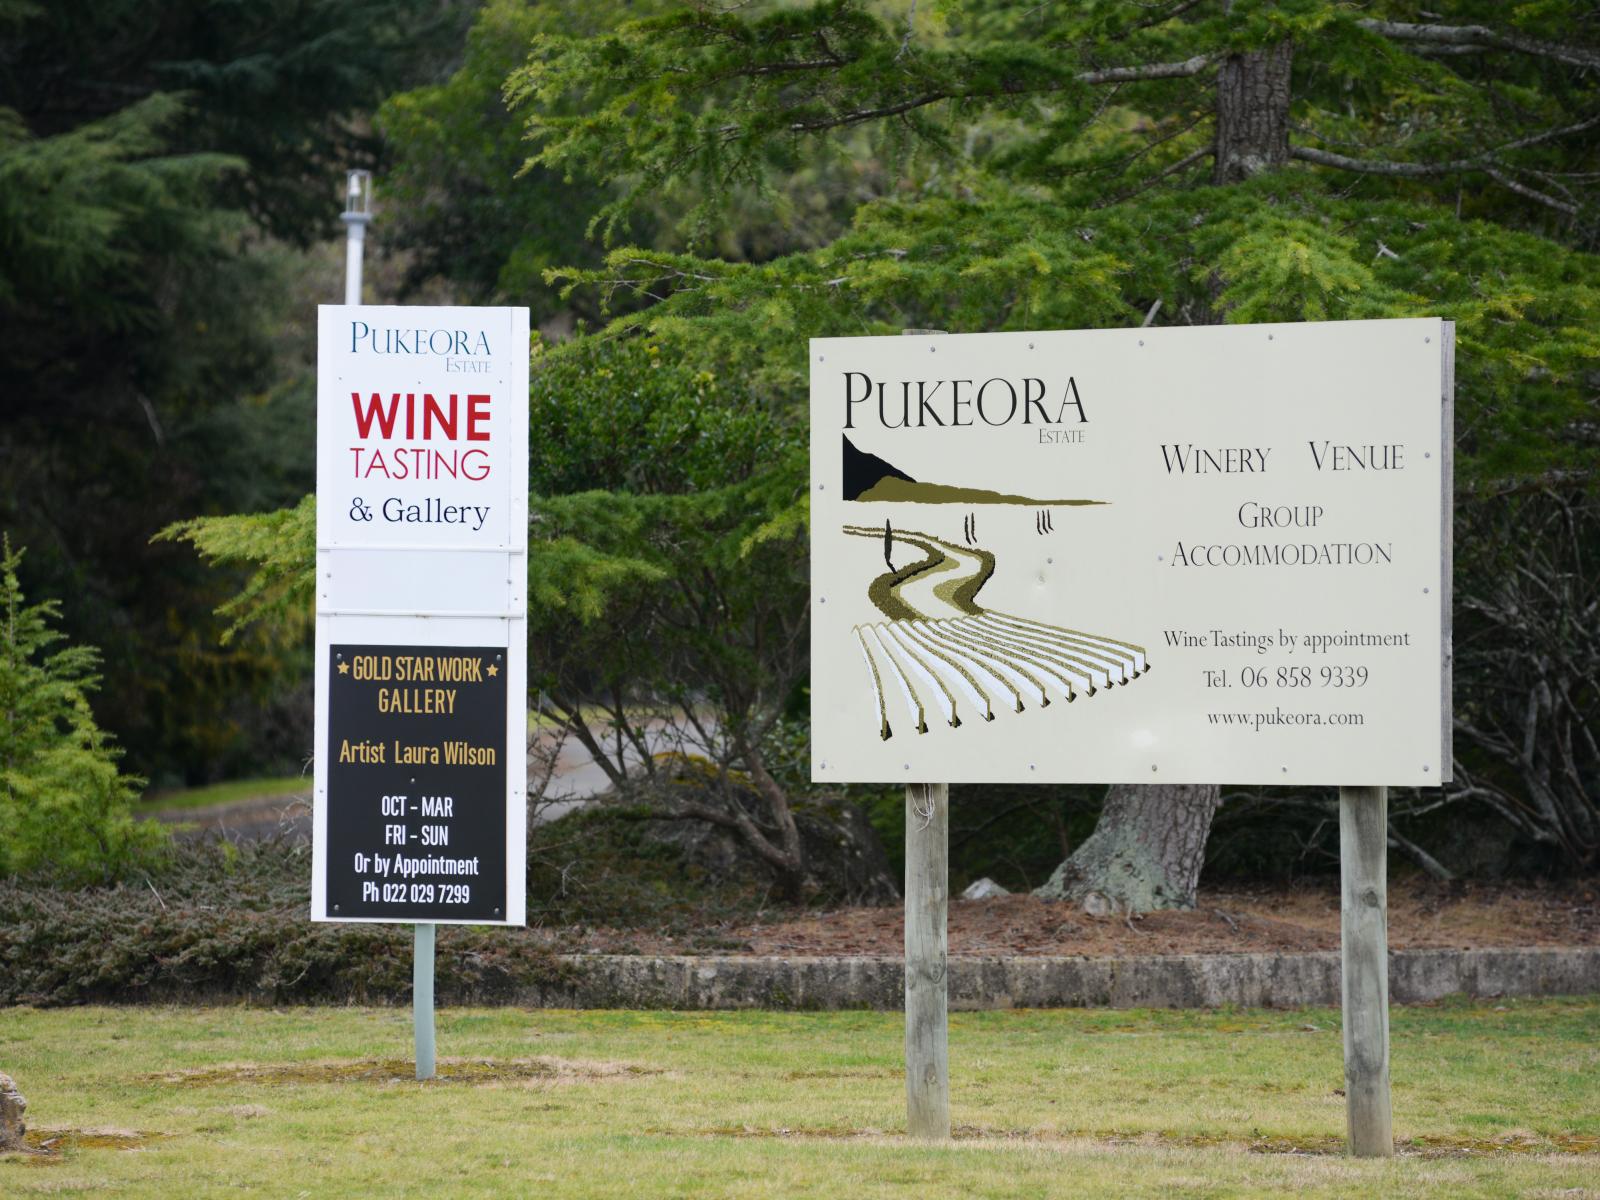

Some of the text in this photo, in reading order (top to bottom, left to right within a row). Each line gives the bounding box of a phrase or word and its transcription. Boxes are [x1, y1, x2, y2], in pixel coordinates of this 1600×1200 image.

[350, 321, 492, 355] PUKEORA
[446, 357, 492, 373] ESTATE
[842, 371, 1089, 429] PUKEORA
[351, 393, 491, 441] WINE
[1039, 428, 1086, 444] ESTATE
[350, 447, 491, 481] TASTING
[1160, 440, 1405, 475] WINERY VENUE
[349, 497, 491, 531] & Gallery
[1238, 502, 1325, 529] GROUP
[1171, 541, 1393, 567] ACCOMMODATION
[1163, 628, 1410, 654] Wine Tastings by appointment
[352, 655, 483, 682] GOLD STAR WORK
[1202, 666, 1369, 688] Tel. 06 858 9339
[378, 688, 457, 714] GALLERY
[1207, 706, 1365, 731] www.pukeora.com
[339, 739, 496, 766] Artist Laura Wilson
[381, 796, 408, 817] OCT
[421, 796, 454, 818] MAR
[385, 825, 407, 846] FRI
[421, 825, 449, 847] SUN
[354, 853, 480, 878] Or by Appointment
[362, 881, 471, 905] Ph 022 029 7299
